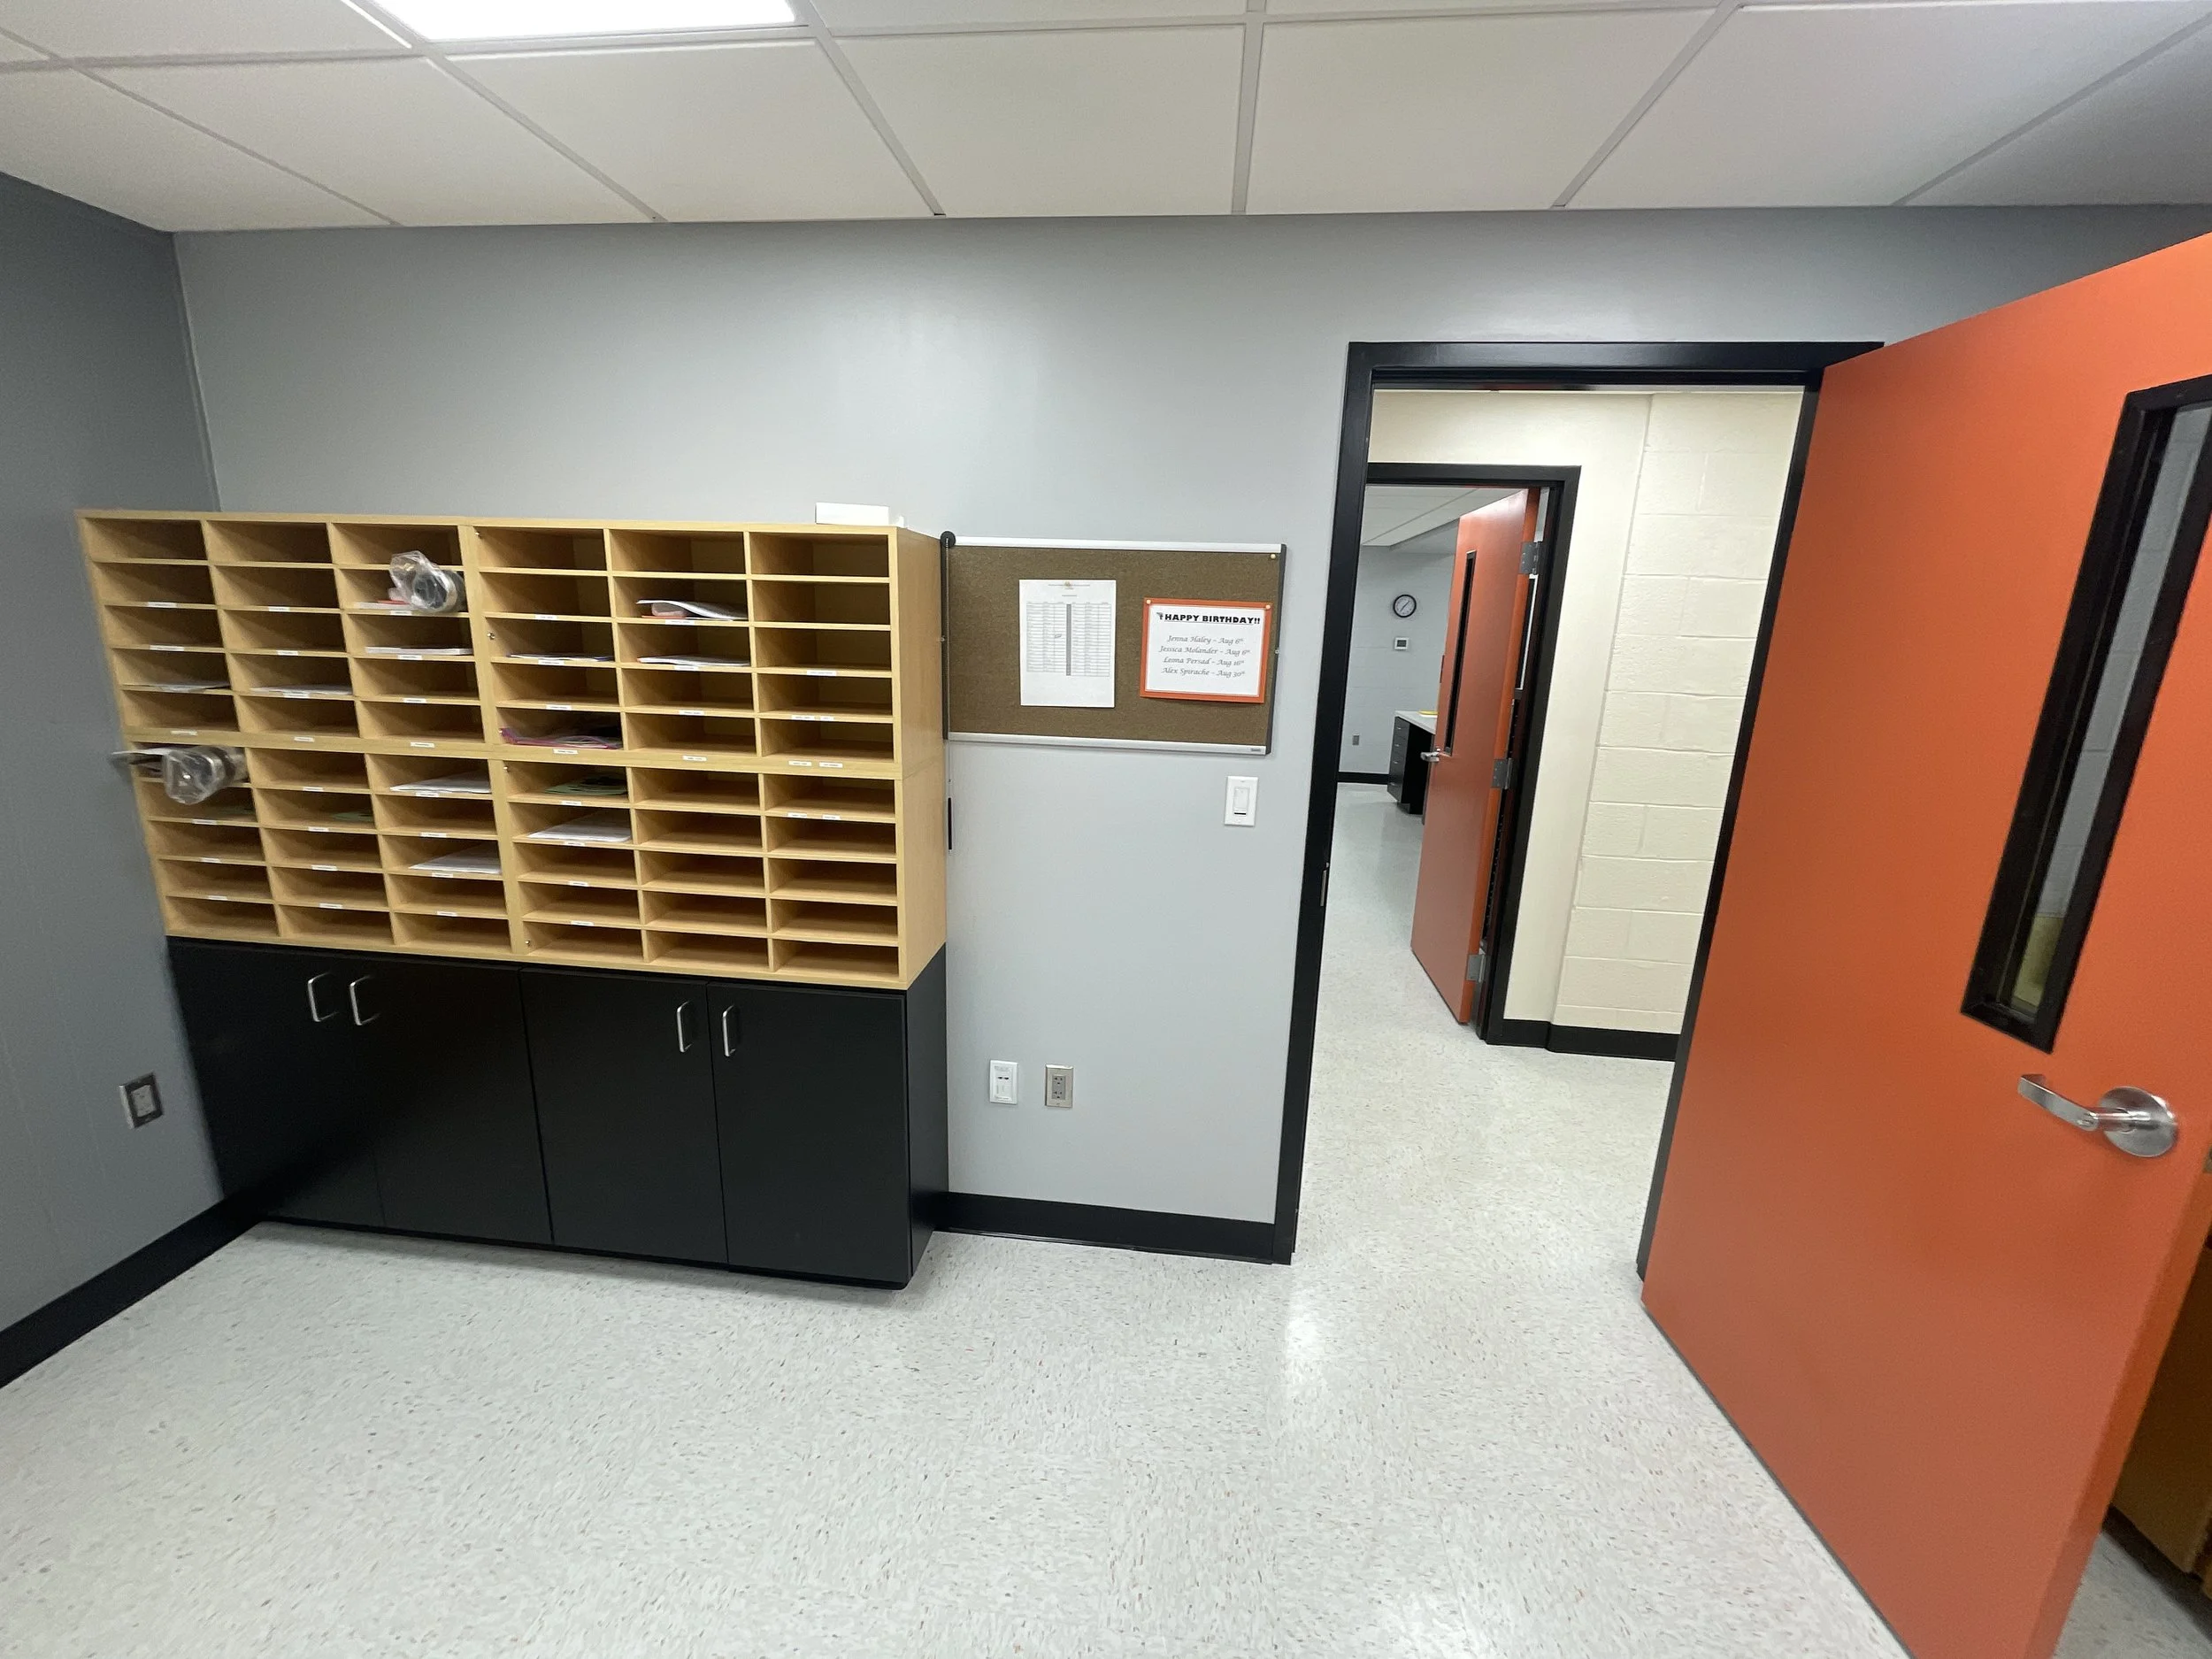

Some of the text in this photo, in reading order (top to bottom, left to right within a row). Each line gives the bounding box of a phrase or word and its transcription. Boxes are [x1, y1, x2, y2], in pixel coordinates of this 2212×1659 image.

[1202, 615, 1261, 625] BIRTHDAY!!
[1190, 635, 1211, 645] Haley
[1218, 637, 1233, 646] Aug
[1217, 670, 1232, 679] Aug
